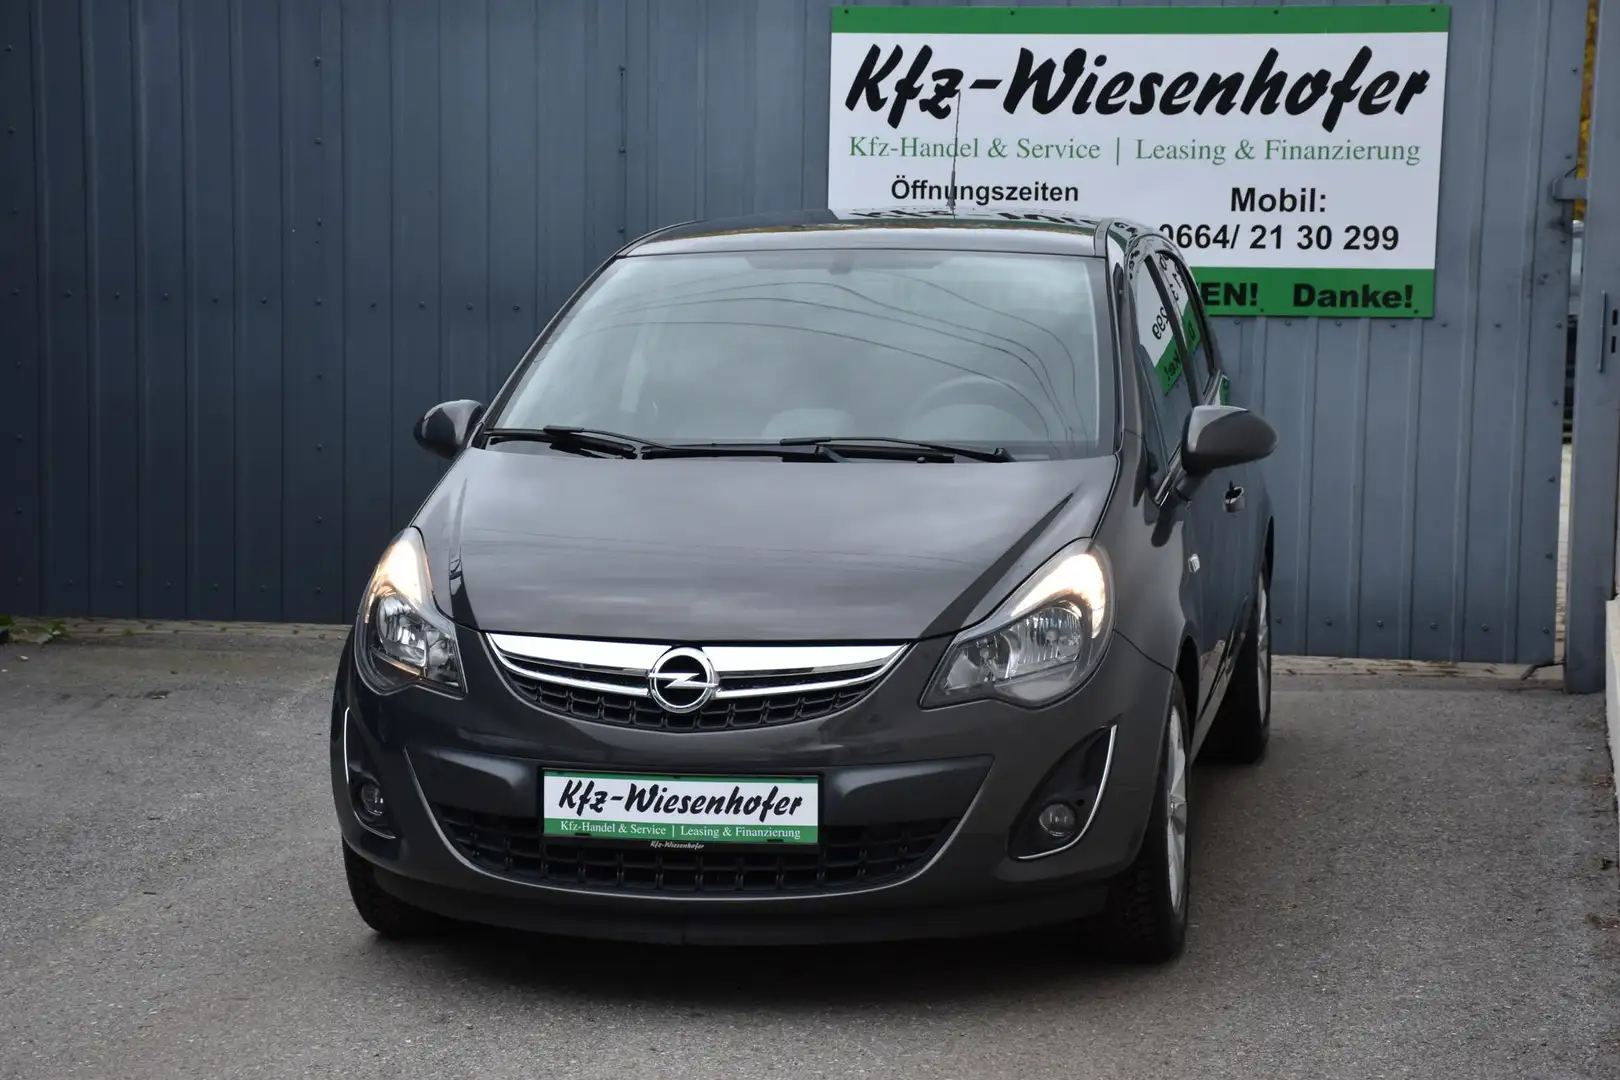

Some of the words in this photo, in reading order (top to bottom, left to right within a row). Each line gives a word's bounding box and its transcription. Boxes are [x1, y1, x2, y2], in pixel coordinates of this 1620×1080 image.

[844, 43, 1431, 133] Kfz-Wiesenhofer
[848, 136, 980, 159] Kfz-Handel
[987, 137, 1008, 159] &
[1016, 138, 1101, 160] Service
[1135, 139, 1227, 166] Leasing
[1234, 139, 1256, 161] &
[1264, 139, 1421, 166] Finanzierung
[891, 175, 1079, 206] Öffnungszeiten
[1230, 187, 1326, 213] Mobil:
[1249, 225, 1282, 250] 21
[1296, 225, 1333, 250] 30
[1343, 225, 1400, 251] 299
[1197, 281, 1259, 307] EN!
[1292, 283, 1414, 309] Danke!
[558, 779, 803, 822] Kfz-Wiesenhofer
[560, 821, 616, 833] Kfz-Handel
[618, 823, 628, 834] &
[630, 824, 667, 835] Service
[680, 826, 719, 838] Leasing
[722, 827, 732, 837] &
[735, 827, 801, 840] Finanzierung
[650, 840, 705, 850] Kfz-Wiesenhofer
